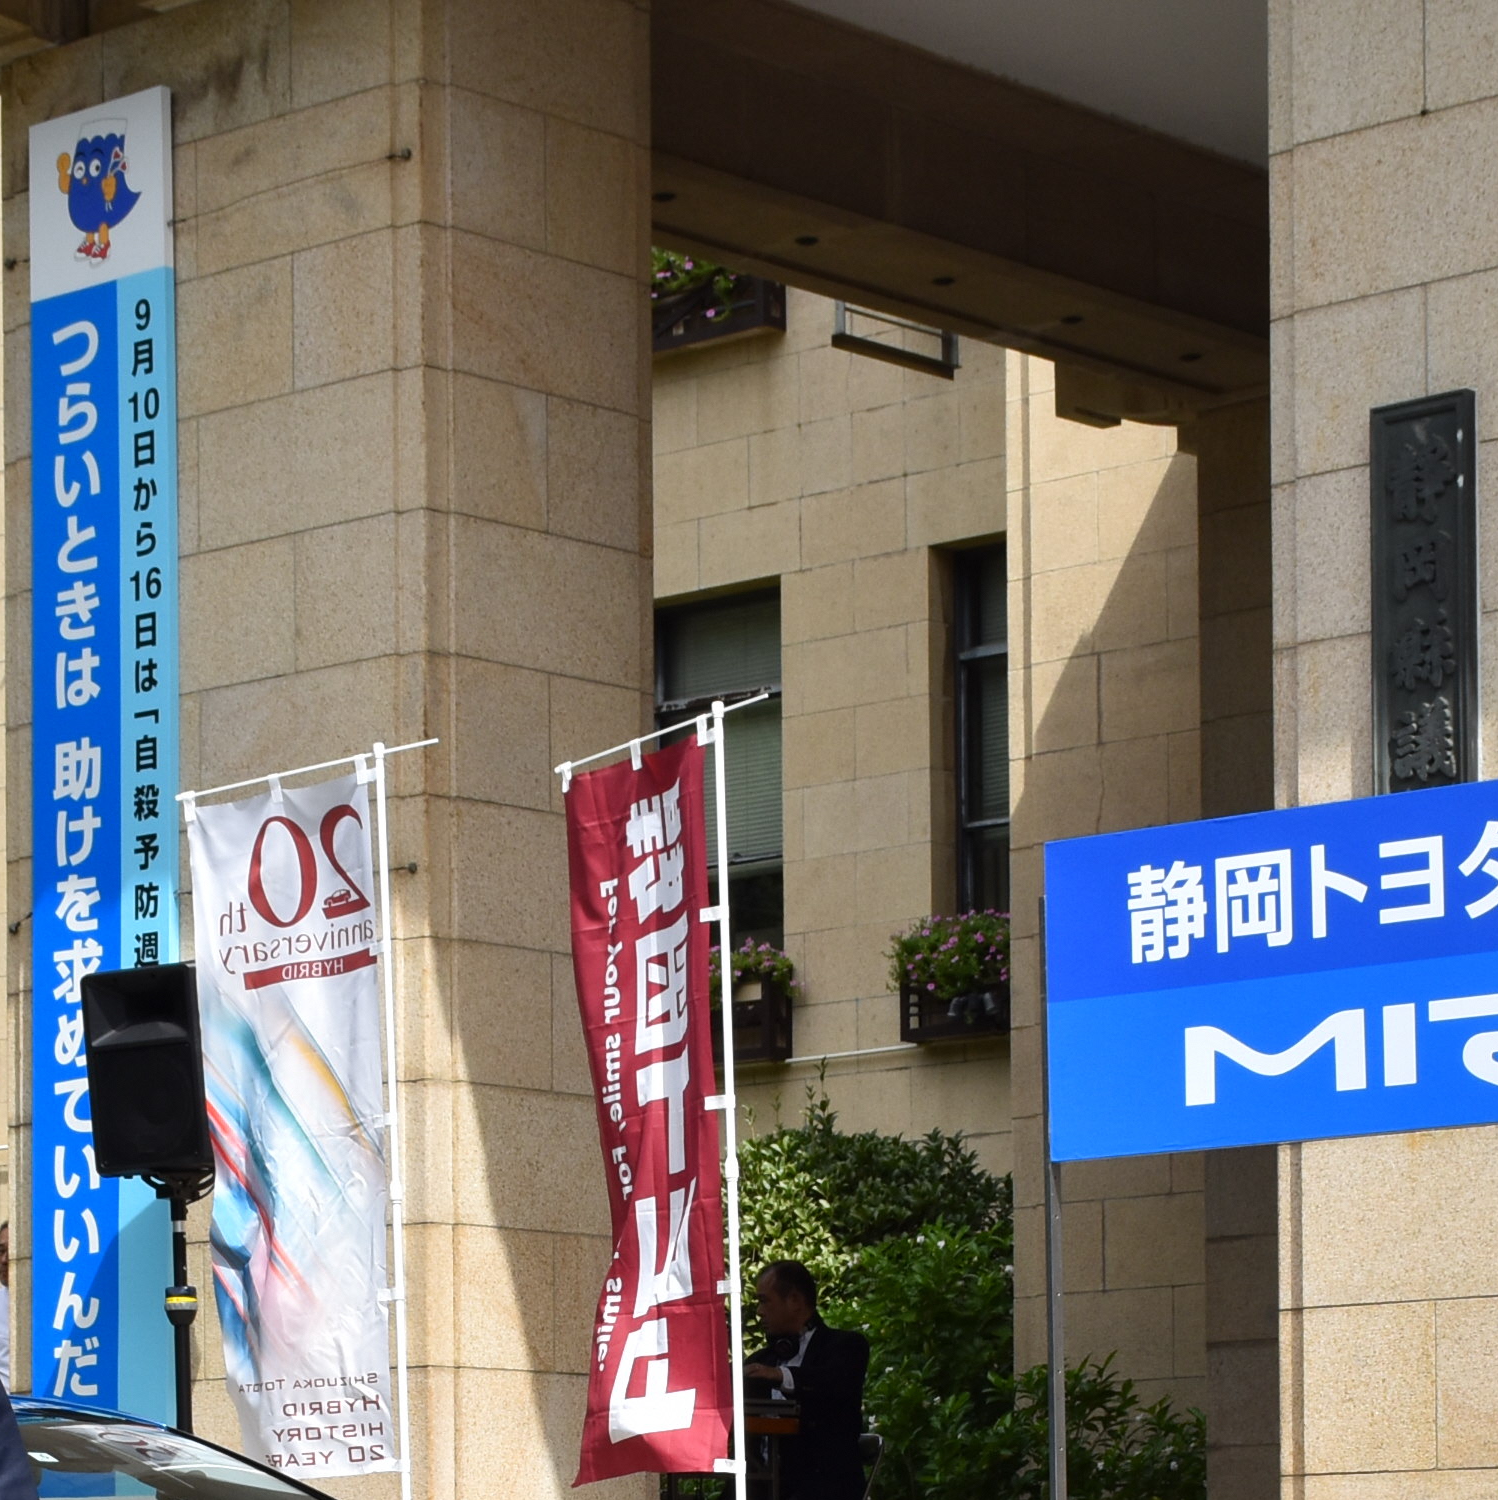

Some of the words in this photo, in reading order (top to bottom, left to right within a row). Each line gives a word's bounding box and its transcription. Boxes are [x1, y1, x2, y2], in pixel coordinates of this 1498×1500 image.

[52, 320, 101, 710] つらいときは
[53, 736, 103, 1398] 助けを求めていいんだ
